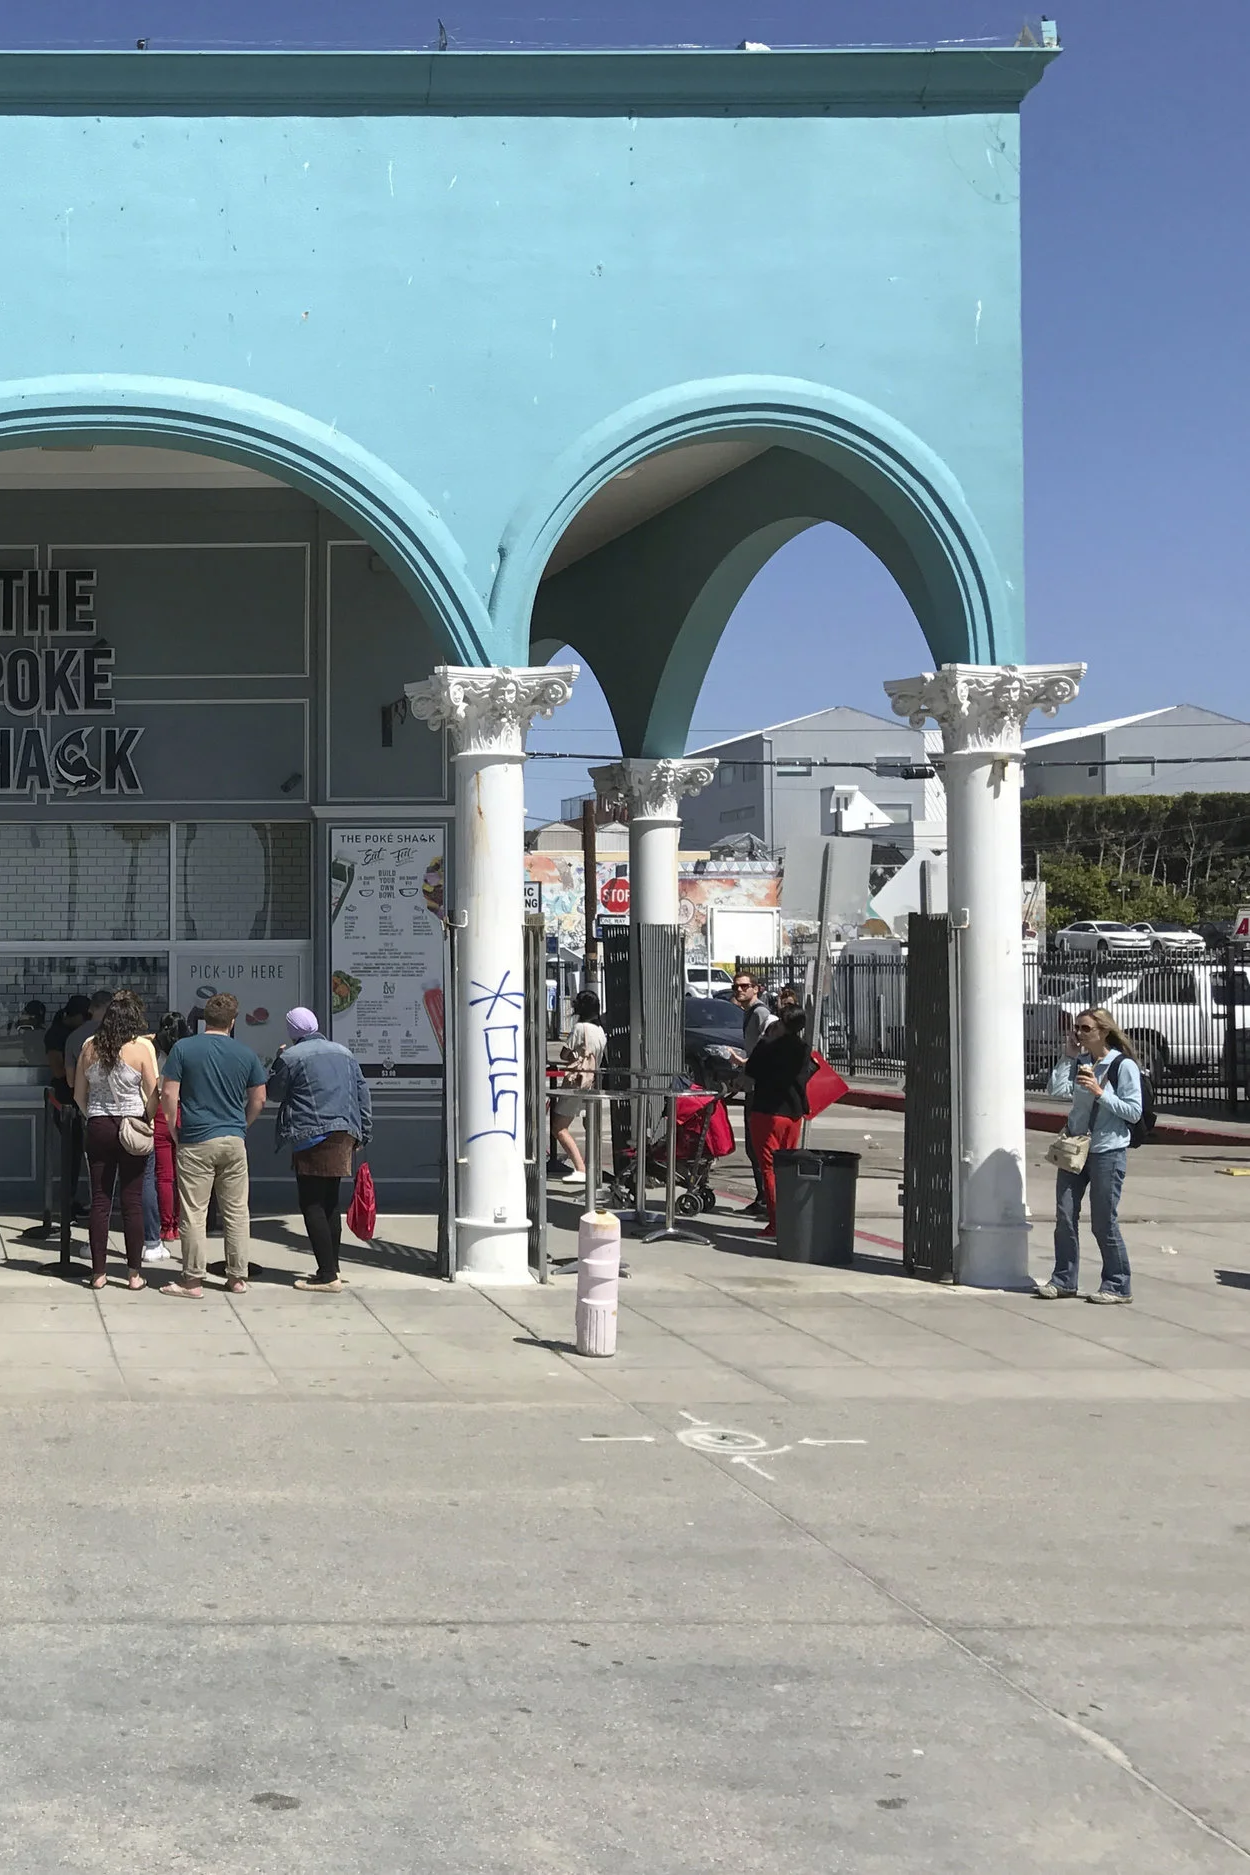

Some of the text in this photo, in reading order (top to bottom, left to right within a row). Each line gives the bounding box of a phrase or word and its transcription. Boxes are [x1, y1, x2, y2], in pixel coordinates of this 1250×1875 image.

[340, 834, 361, 843] THE
[378, 869, 397, 877] BUILD
[524, 887, 534, 897] IC
[524, 898, 538, 908] NG
[190, 965, 284, 979] PICK-UP HERE
